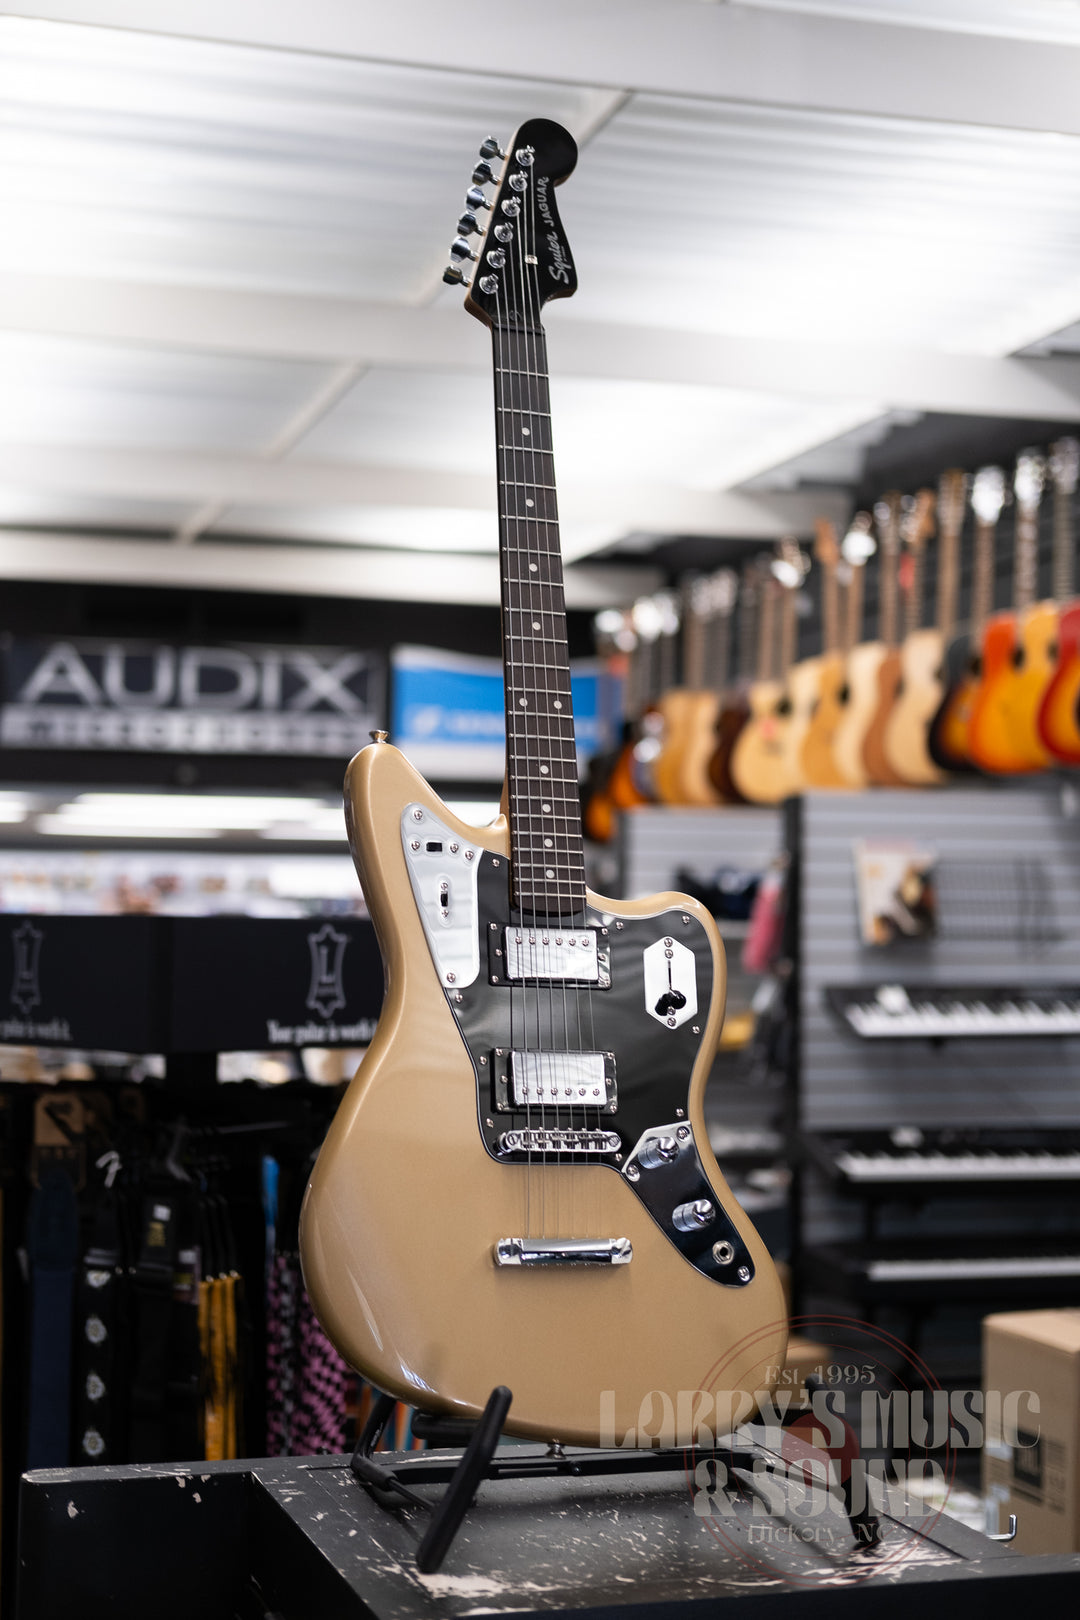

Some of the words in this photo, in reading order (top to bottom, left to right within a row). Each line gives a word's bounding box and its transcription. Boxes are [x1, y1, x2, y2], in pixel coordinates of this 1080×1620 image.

[536, 176, 555, 227] JAGUAR
[548, 230, 572, 285] Squier
[20, 642, 368, 714] AUDIX
